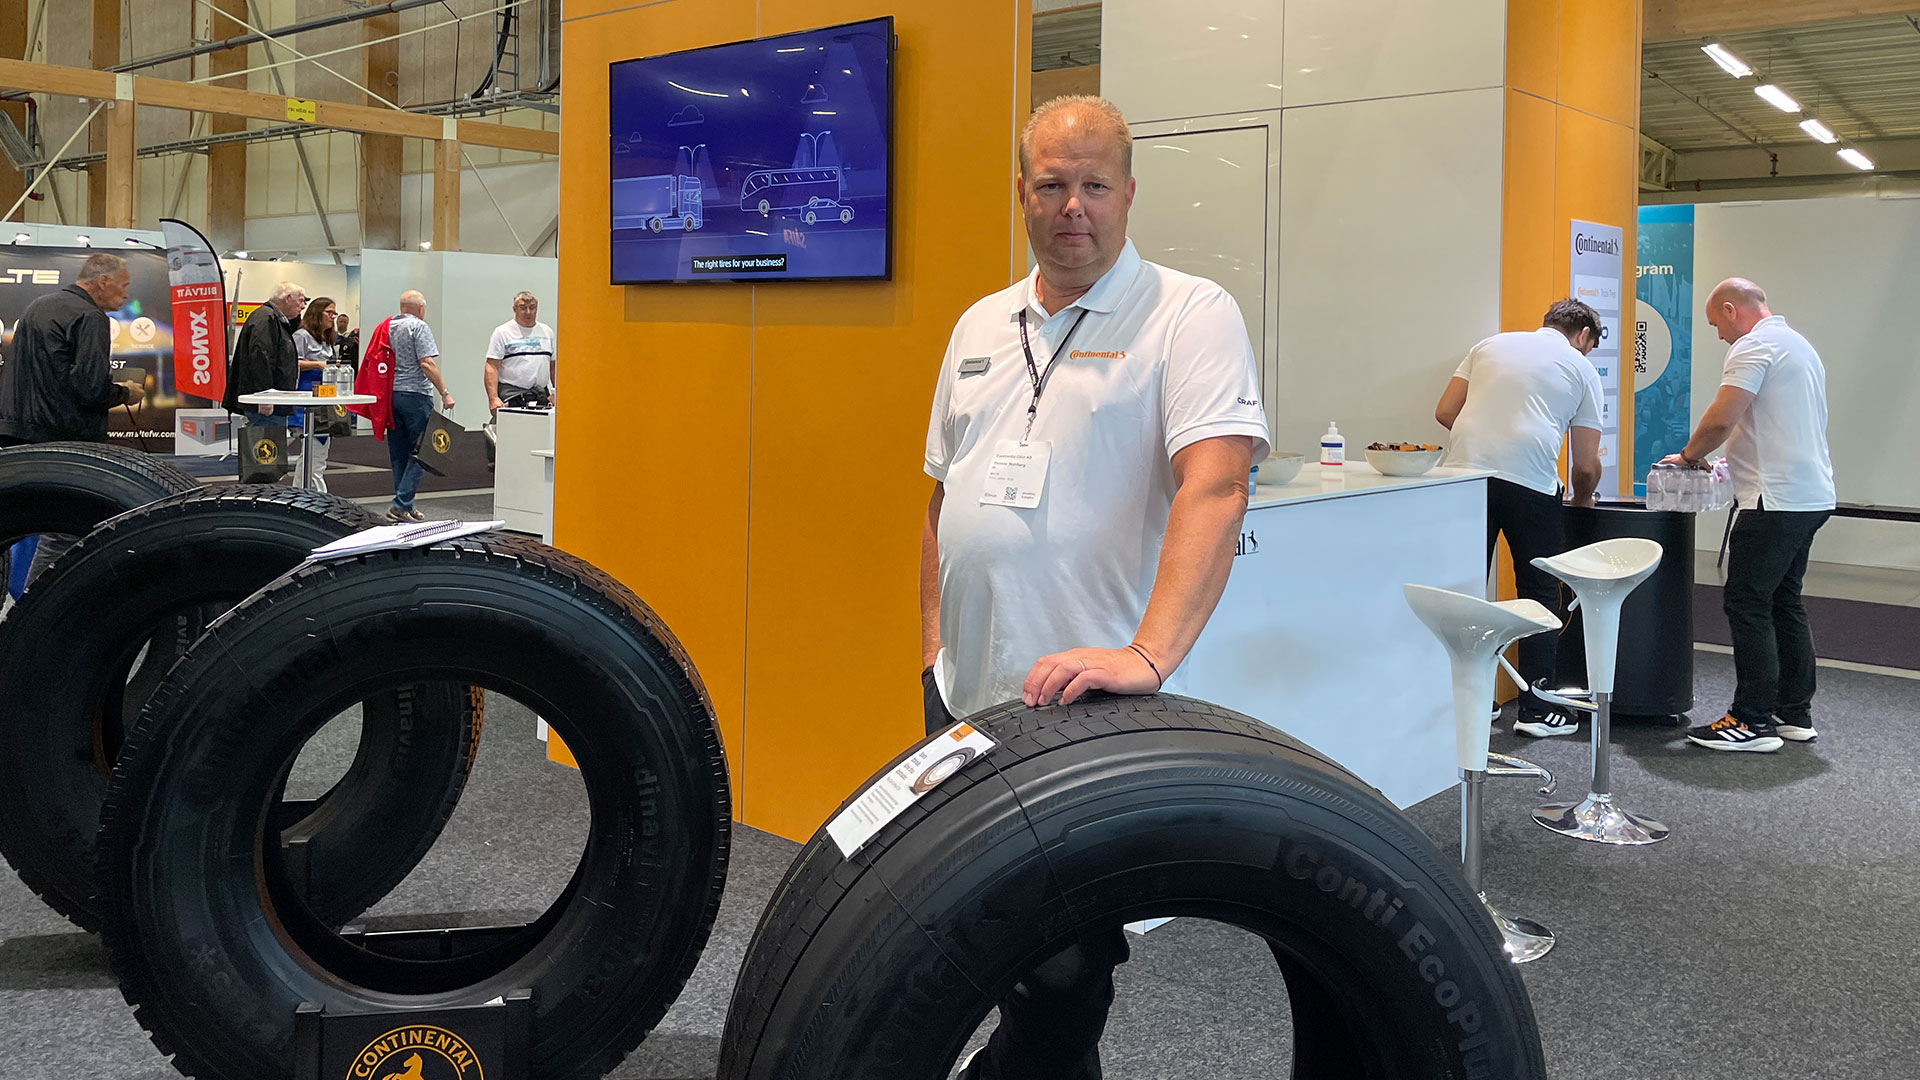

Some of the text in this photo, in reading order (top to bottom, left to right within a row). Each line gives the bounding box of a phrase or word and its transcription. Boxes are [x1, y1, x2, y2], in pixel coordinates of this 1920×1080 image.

[1576, 233, 1614, 255] Continental
[693, 260, 704, 268] The
[705, 259, 718, 270] right
[732, 259, 740, 267] for
[741, 260, 755, 269] your
[756, 257, 785, 267] business?
[1070, 350, 1118, 360] Continental
[1285, 842, 1404, 926] Conti
[355, 1030, 473, 1077] CONTINENTAL
